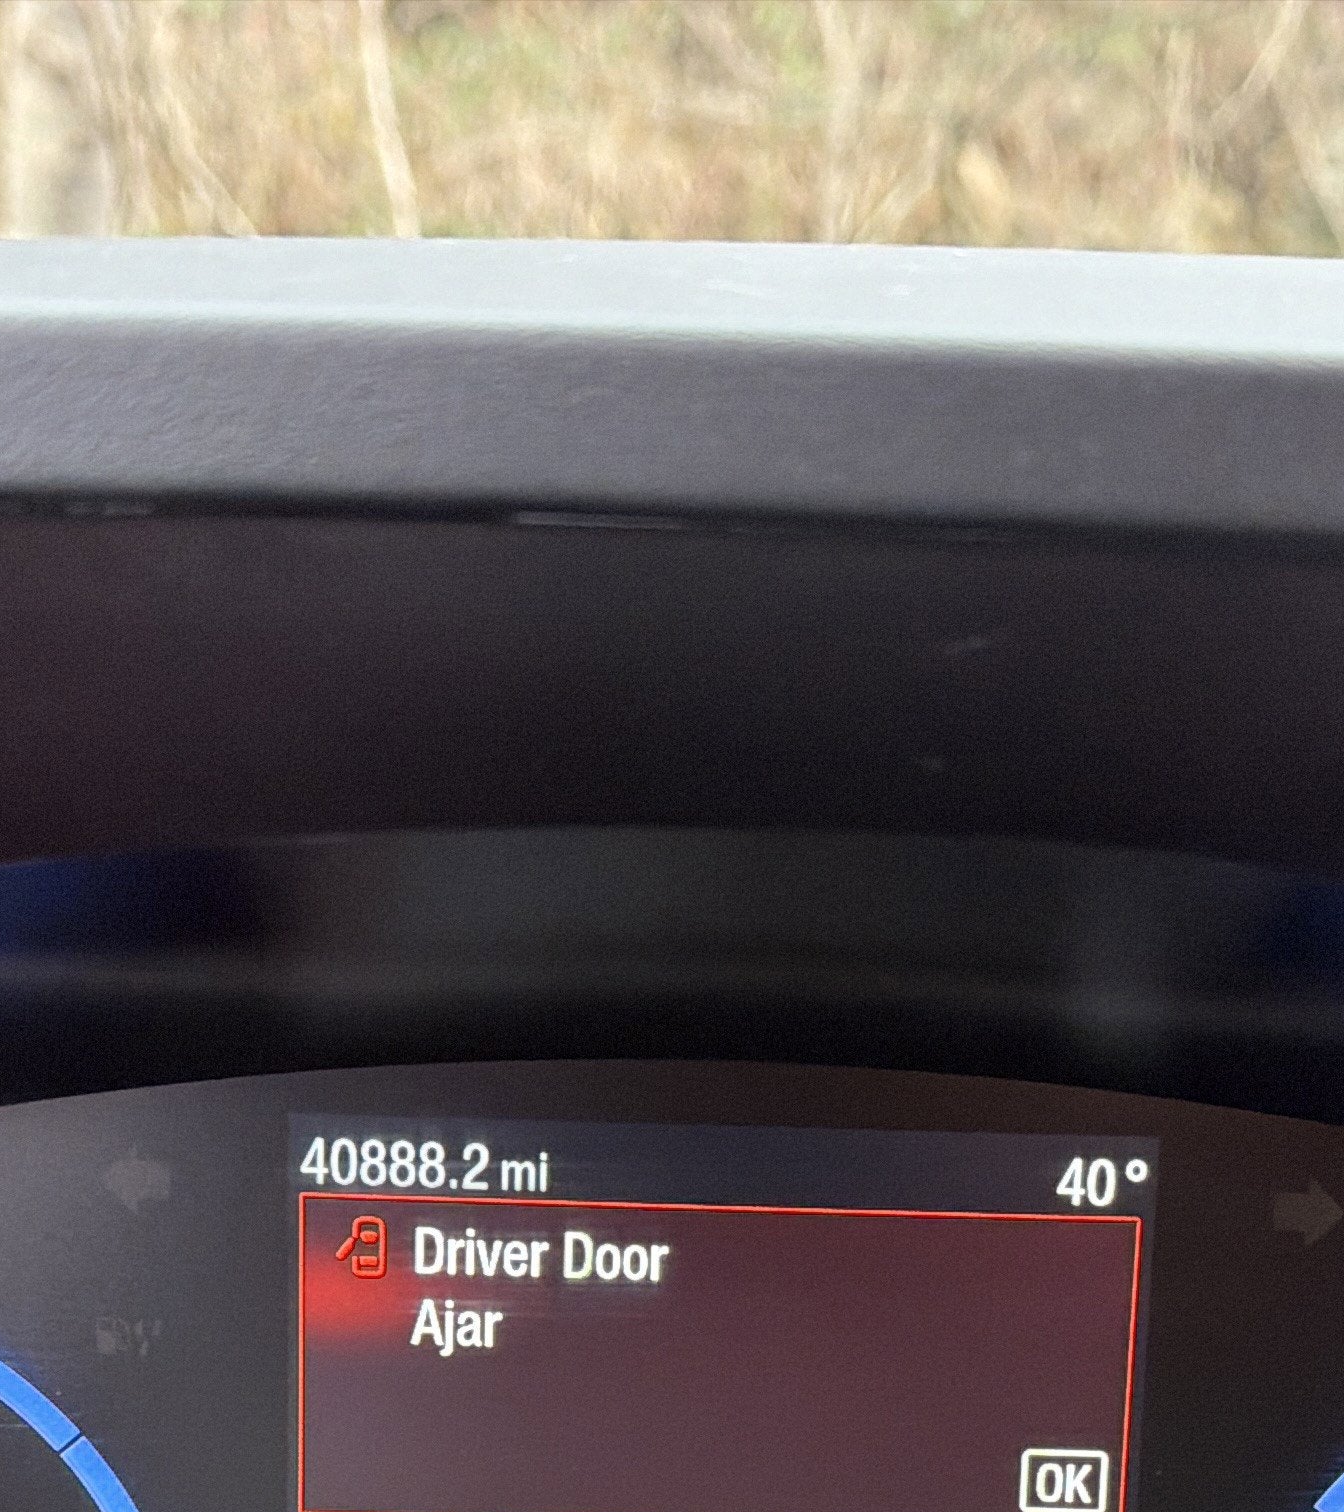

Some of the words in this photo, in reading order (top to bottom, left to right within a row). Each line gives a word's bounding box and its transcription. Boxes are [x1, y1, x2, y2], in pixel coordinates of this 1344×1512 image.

[299, 1137, 489, 1190] 40888.2
[501, 1152, 547, 1192] mi
[413, 1226, 550, 1279] Driver
[563, 1231, 670, 1282] Door
[410, 1298, 503, 1357] Ajar
[1036, 1463, 1092, 1504] OK
